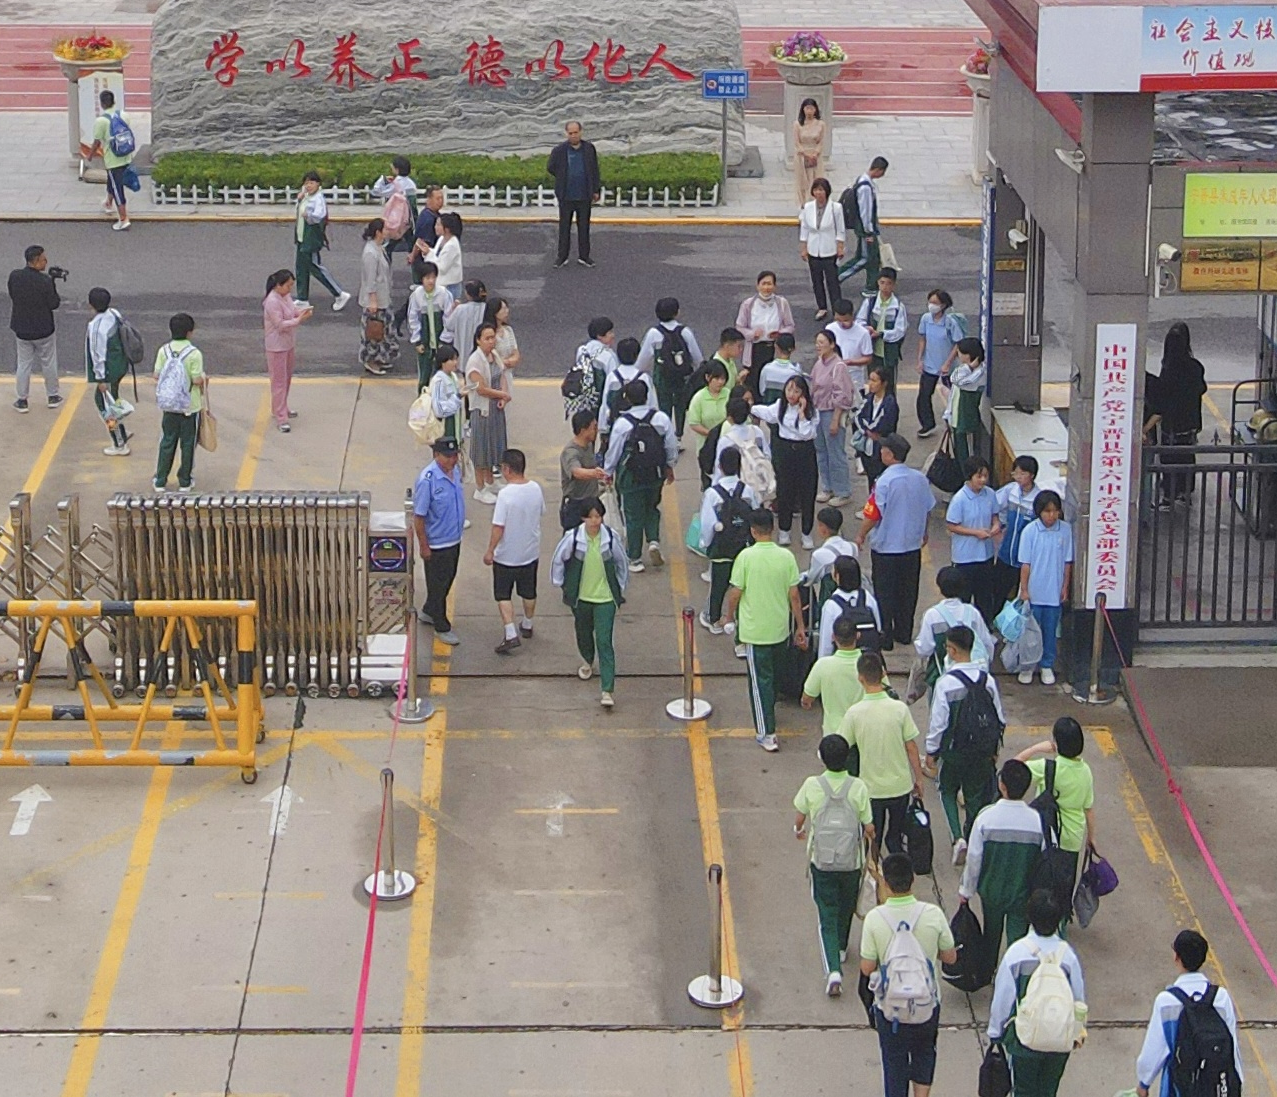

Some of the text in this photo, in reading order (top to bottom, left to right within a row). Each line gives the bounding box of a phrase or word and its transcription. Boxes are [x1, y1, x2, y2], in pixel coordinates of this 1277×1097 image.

[1096, 343, 1127, 592] 中国共产党宁晋县第六中学总支部委员会
